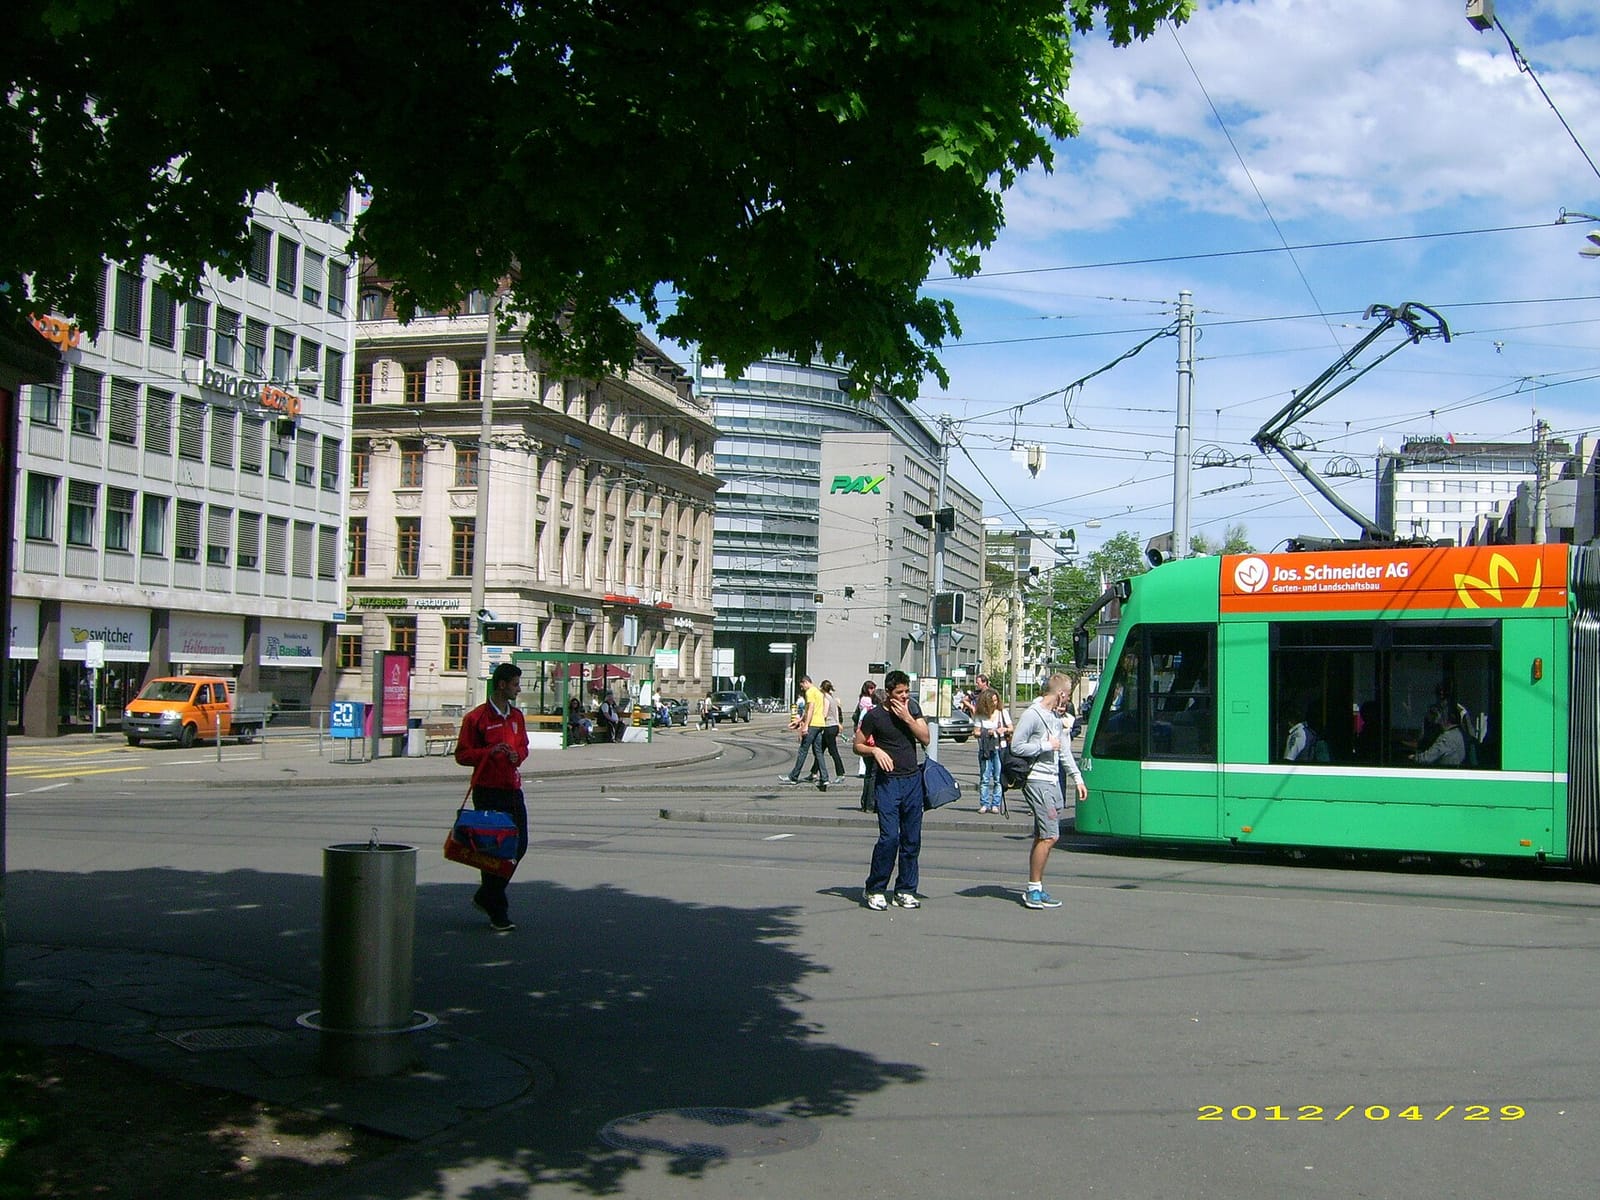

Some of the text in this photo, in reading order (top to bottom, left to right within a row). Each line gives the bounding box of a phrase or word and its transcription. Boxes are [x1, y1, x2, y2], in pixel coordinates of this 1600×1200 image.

[830, 475, 885, 494] PAX
[1272, 562, 1409, 581] Jos. Schneider AG
[1272, 582, 1380, 592] Garten- und Landschaftsbau
[415, 597, 460, 609] restaurant
[89, 627, 133, 642] switcher
[279, 645, 312, 657] Basilisk
[333, 703, 353, 722] 20
